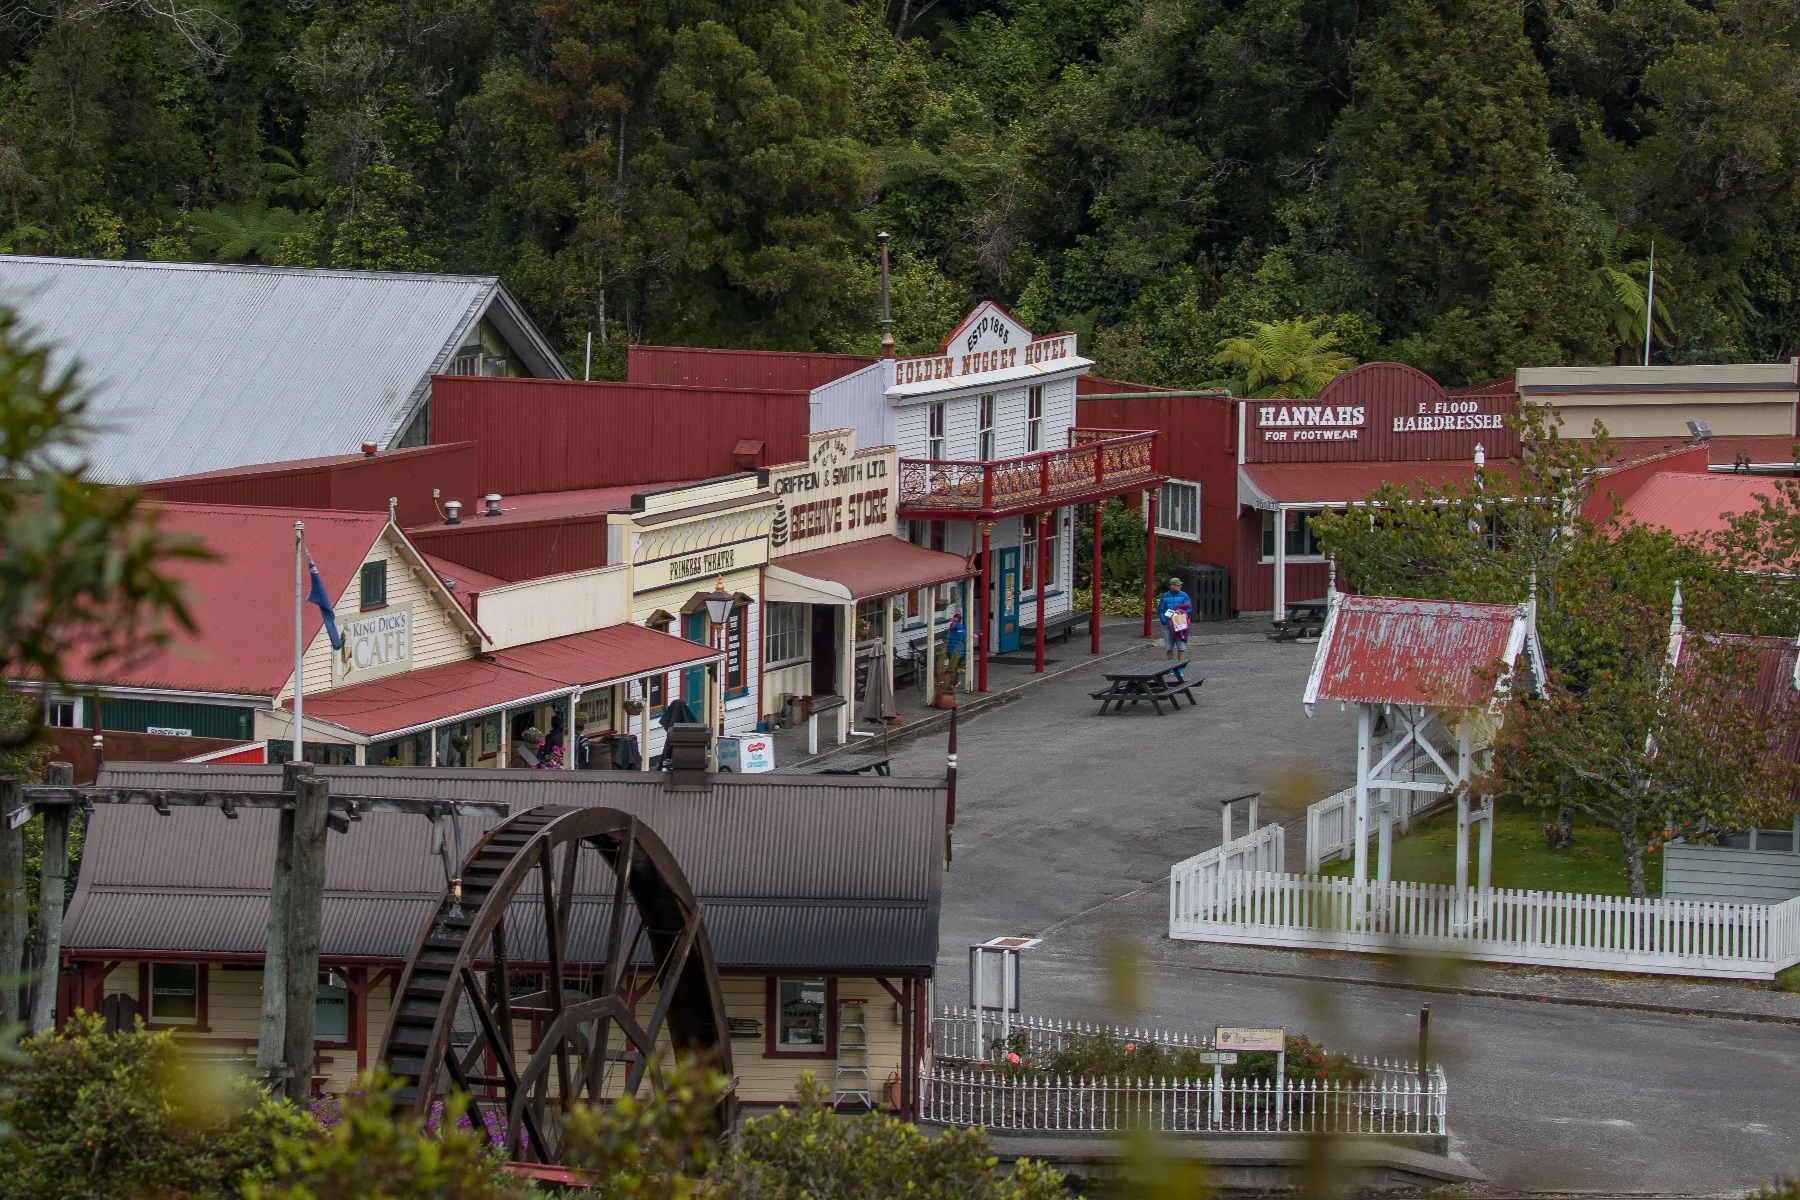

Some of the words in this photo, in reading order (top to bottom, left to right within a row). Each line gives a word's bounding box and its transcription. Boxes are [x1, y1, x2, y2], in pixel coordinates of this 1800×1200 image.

[967, 316, 988, 353] ESTD
[896, 357, 954, 386] GOLDEN
[962, 347, 1017, 376] NUGGET
[1025, 338, 1067, 365] HOTEL
[1259, 406, 1365, 426] HANNAHS
[1418, 402, 1431, 414] E.
[1434, 401, 1478, 414] FLOOD
[1264, 431, 1287, 441] FOR
[1293, 429, 1358, 441] FOOTWEAR
[1392, 414, 1503, 432] HAIRDRESSER
[824, 469, 830, 487] &
[832, 463, 863, 486] SMITH
[867, 459, 888, 480] LTD.
[789, 496, 843, 542] BEEHIVE
[848, 488, 889, 530] STORE
[669, 556, 702, 581] PRINCESS
[703, 549, 735, 573] THEATRE
[353, 620, 376, 637] KING
[354, 629, 406, 669] CAFE
